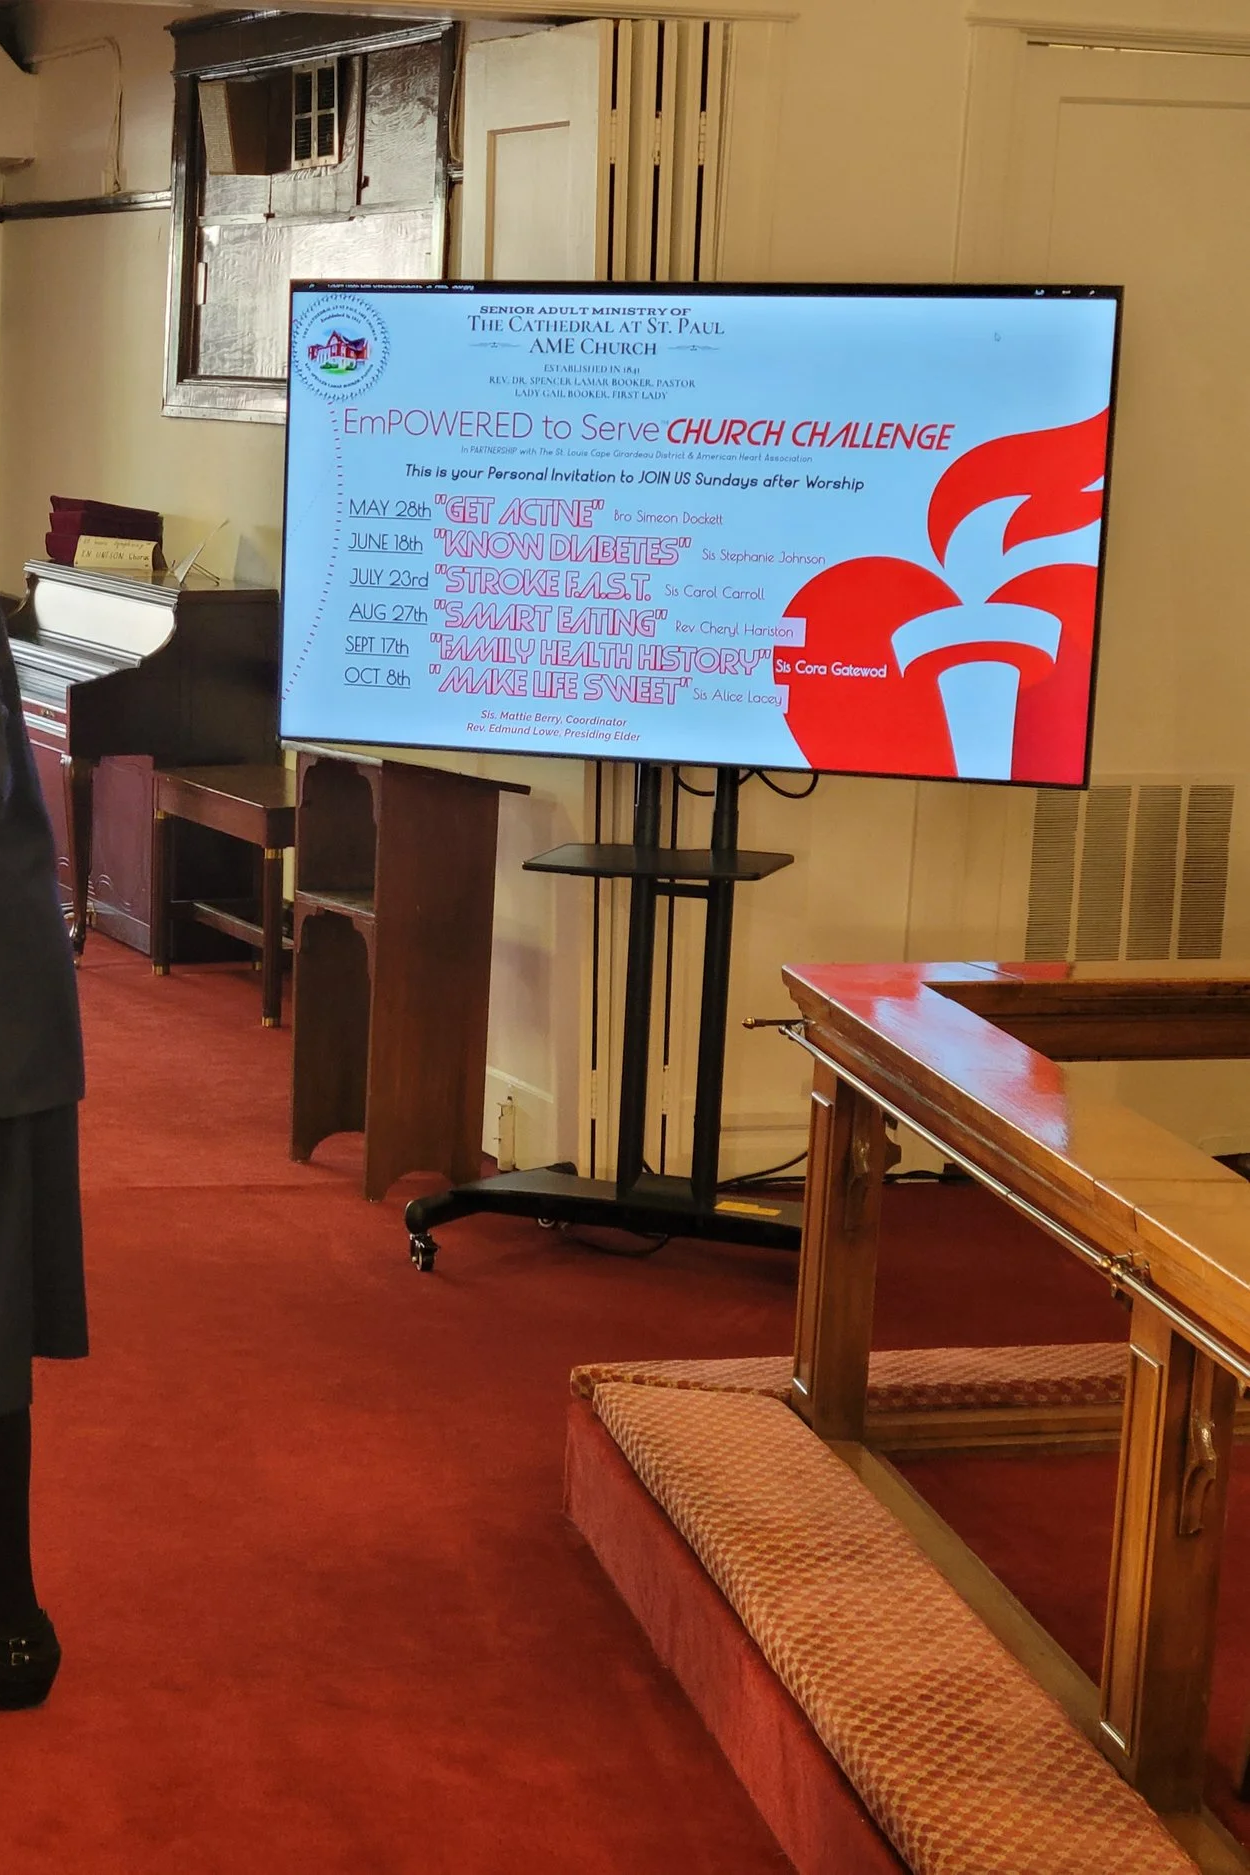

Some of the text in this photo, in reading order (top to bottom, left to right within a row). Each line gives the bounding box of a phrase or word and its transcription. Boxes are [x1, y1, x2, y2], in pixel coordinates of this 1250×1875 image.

[480, 306, 692, 316] SENIOR ADULT MINISTRY OF
[529, 338, 656, 355] AME CHURCH
[544, 364, 607, 373] ESTABLISHED
[610, 365, 620, 373] IN
[515, 388, 540, 397] LADY
[543, 389, 565, 398] GAIL
[612, 391, 639, 399] FIRST
[642, 392, 667, 400] LADY
[530, 377, 572, 386] SPENCER
[574, 378, 609, 386] LAMAR
[657, 379, 695, 388] PASTOR
[344, 408, 955, 450] EmPOWERED to Serve CHURCH CHALLENGE
[470, 446, 517, 455] PARTNERSHIP
[591, 450, 610, 458] Cape
[613, 450, 653, 458] Girardeau
[656, 451, 685, 459] District
[696, 452, 737, 460] American
[739, 453, 762, 461] Heart
[764, 454, 812, 462] Association
[405, 464, 864, 493] This is your Personal Invitation to JOIN US Sundays after Worship
[349, 498, 389, 516] MAY
[396, 500, 431, 518] 28th
[435, 494, 495, 524] "GET
[614, 510, 632, 522] Bro
[637, 510, 678, 523] Simeon
[683, 512, 723, 525] Dockett
[348, 528, 826, 565] JUNE 18th "KNOW DIABETES" Sis Stephanie Johnson
[349, 568, 384, 585] JULY
[389, 570, 429, 588] 23rd
[435, 564, 560, 597] "STROKE
[665, 584, 679, 596] Sis
[684, 585, 716, 598] Carol
[722, 587, 764, 600] Carroll
[349, 599, 794, 637] AUG 27th "SMART EATING" Rev Cheryl Hariston
[346, 632, 887, 678] SEPT 17th "FAMILY HEALTH HISTORY" Sis Cora Gatewod
[344, 667, 381, 685] OCT
[386, 669, 410, 686] 8th
[533, 670, 578, 699] LIFE
[584, 673, 693, 704] SWEET"
[693, 688, 707, 701] Sis
[713, 689, 743, 702] Alice
[748, 691, 782, 706] Lacey
[481, 710, 627, 727] Sis. Mattie Berry, Coordinator
[466, 723, 486, 732] Rev.
[488, 723, 530, 735] Edmund
[564, 730, 611, 741] Presiding
[614, 732, 640, 742] Elder
